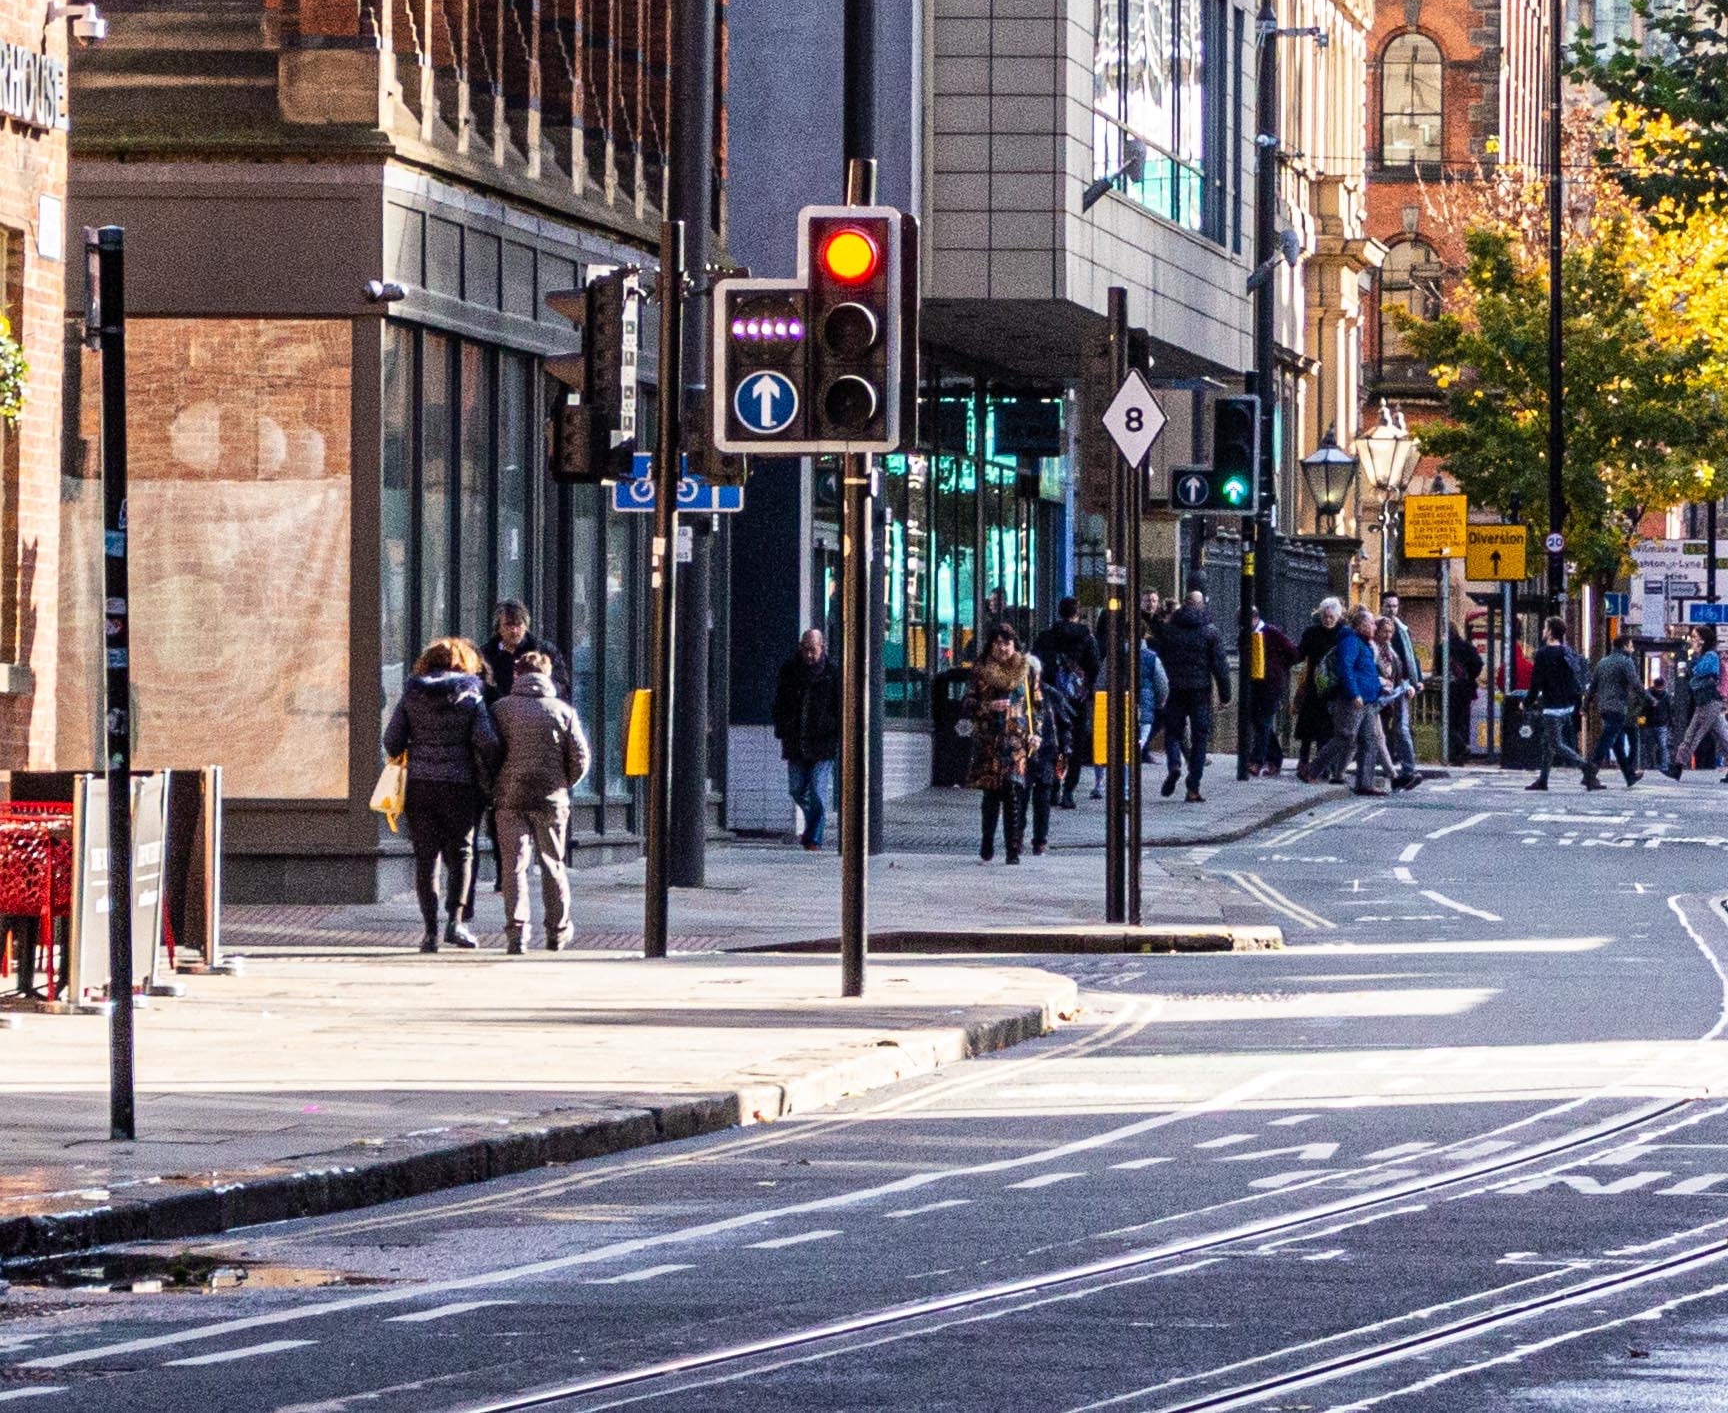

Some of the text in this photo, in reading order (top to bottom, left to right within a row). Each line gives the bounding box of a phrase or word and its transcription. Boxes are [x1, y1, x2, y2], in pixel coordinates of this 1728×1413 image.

[1124, 407, 1144, 433] 8
[1468, 531, 1524, 545] Diversion
[1549, 537, 1563, 548] 20
